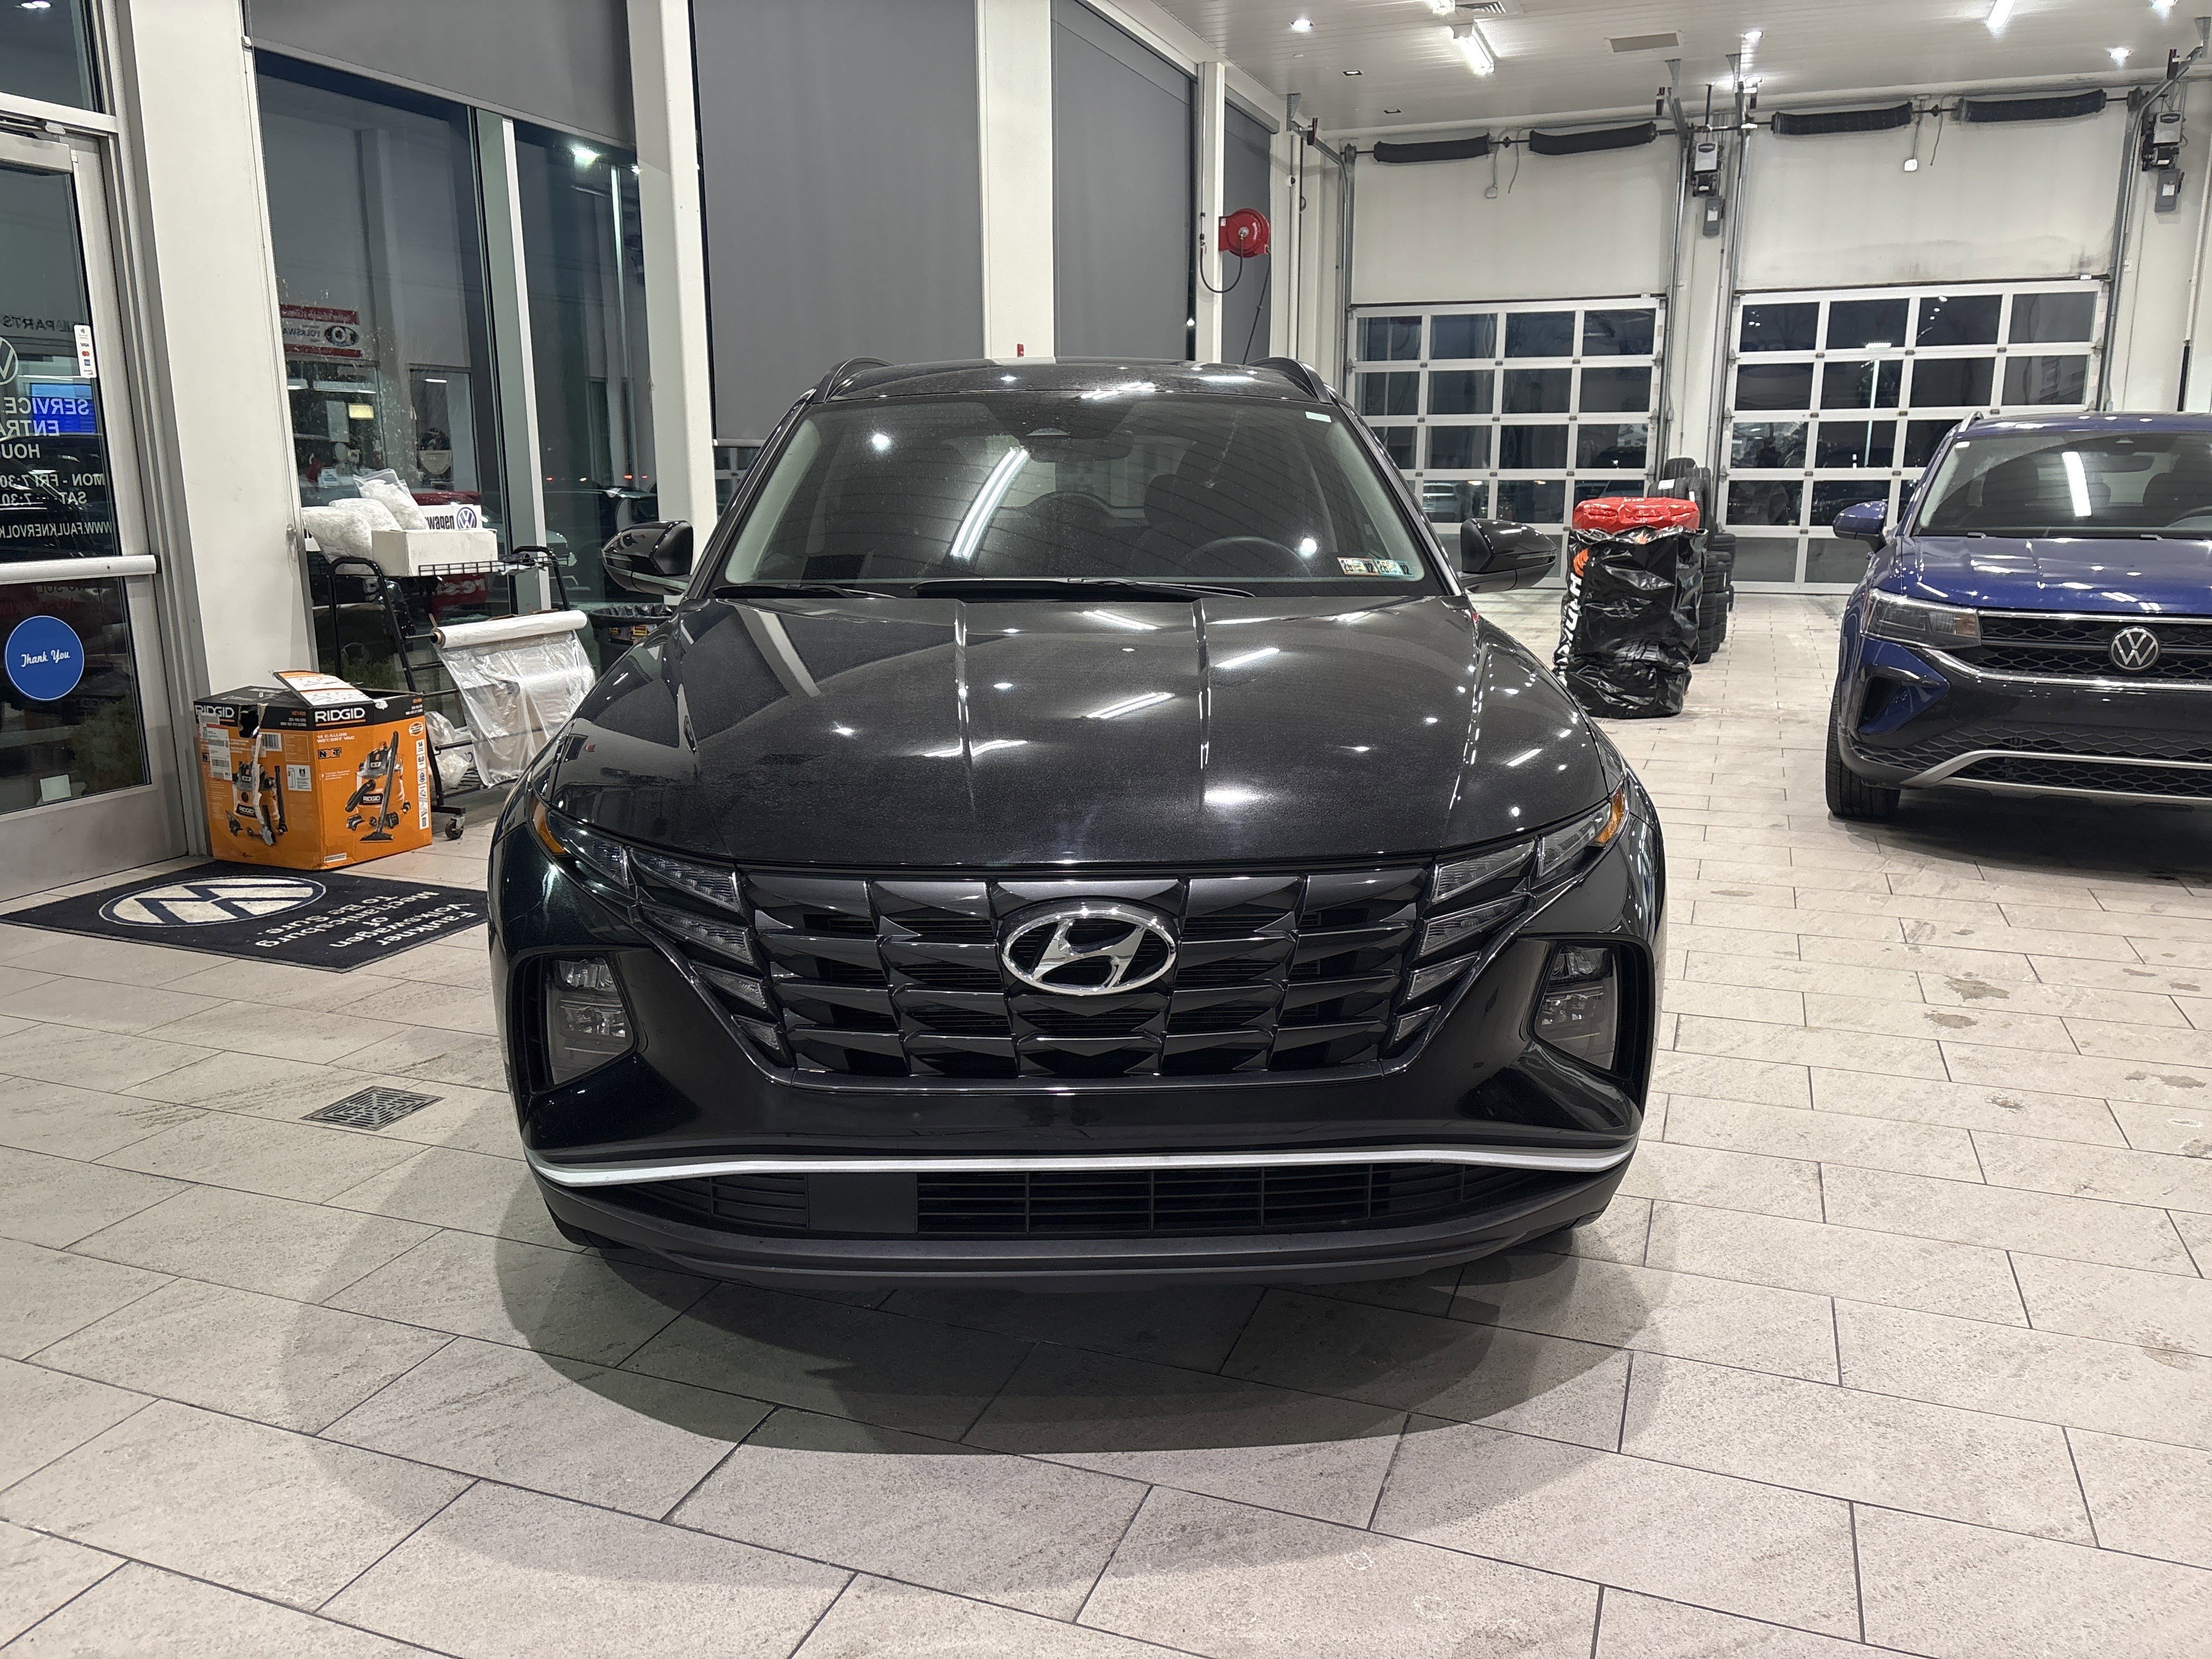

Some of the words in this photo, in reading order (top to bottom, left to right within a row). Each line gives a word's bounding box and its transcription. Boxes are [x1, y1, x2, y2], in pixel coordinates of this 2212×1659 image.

[20, 651, 48, 668] Thank
[50, 648, 71, 664] You
[194, 704, 235, 718] RIDGID
[314, 707, 366, 723] RIDGID
[318, 748, 341, 759] NXT
[362, 896, 398, 904] To
[327, 904, 366, 915] Be
[255, 891, 439, 947] Mechanicsburg
[257, 915, 330, 935] Sure.
[329, 903, 471, 947] Volkswagen
[362, 917, 388, 927] of
[376, 911, 477, 945] Faulkner
